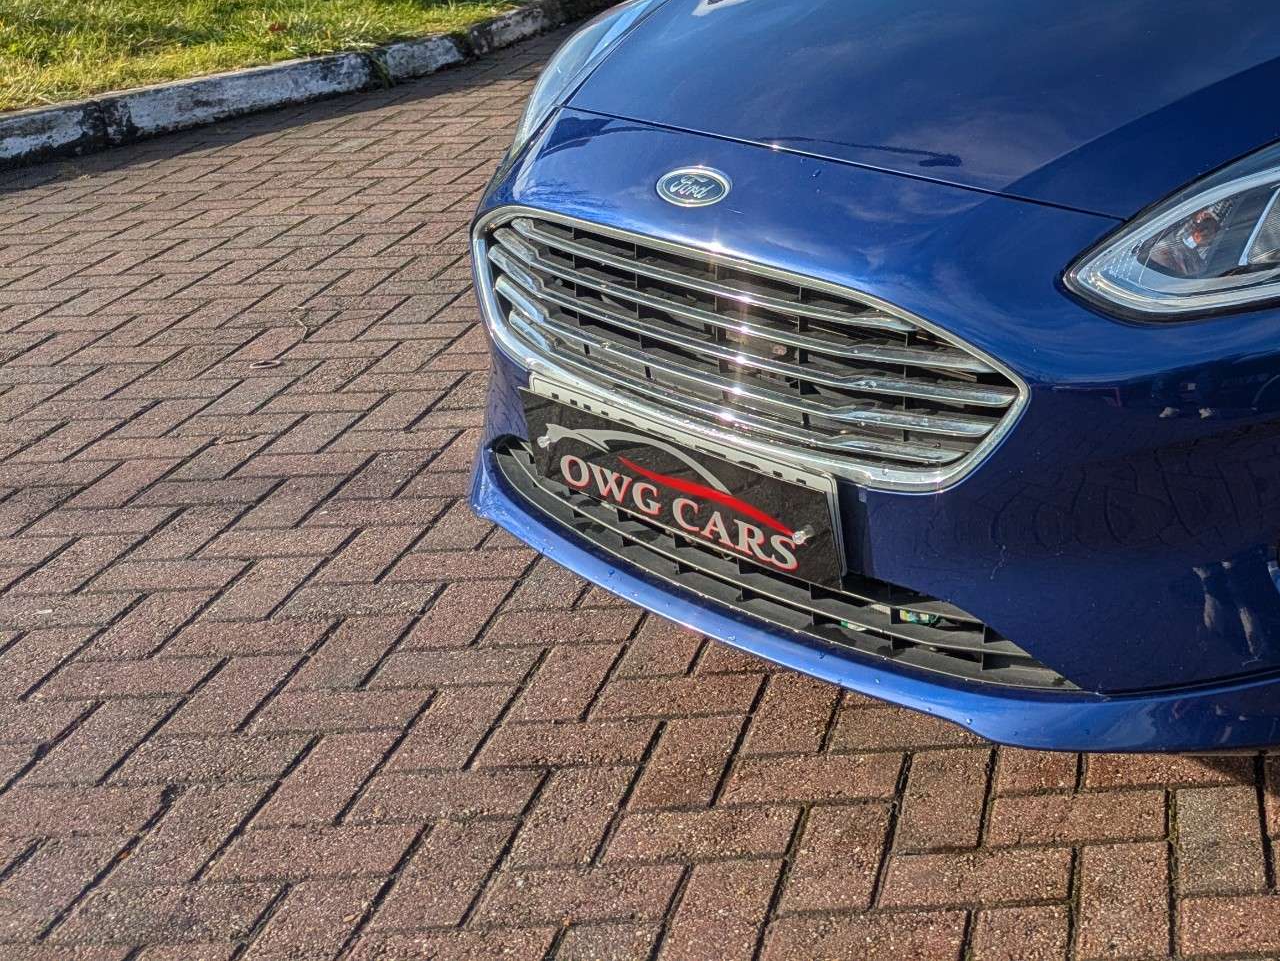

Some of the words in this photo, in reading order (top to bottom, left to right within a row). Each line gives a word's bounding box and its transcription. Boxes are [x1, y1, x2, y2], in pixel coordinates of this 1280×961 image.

[670, 174, 716, 199] Ford
[560, 454, 662, 515] OWG
[672, 497, 800, 572] CARS
